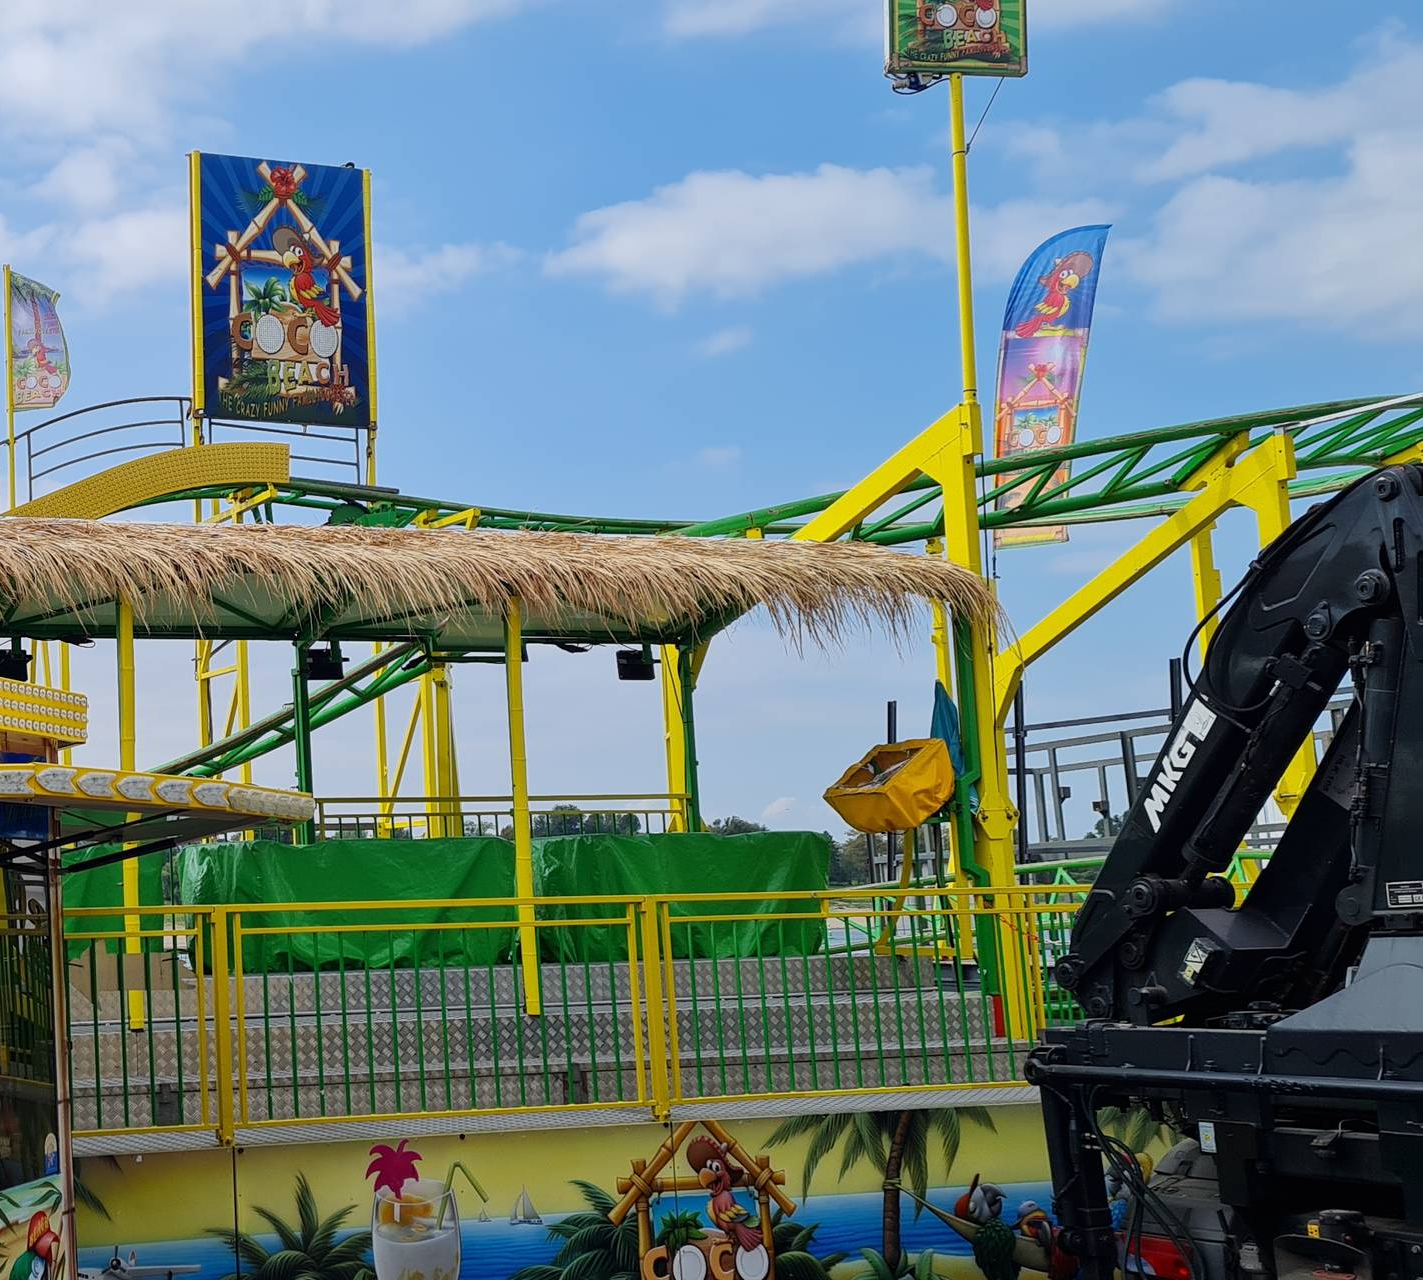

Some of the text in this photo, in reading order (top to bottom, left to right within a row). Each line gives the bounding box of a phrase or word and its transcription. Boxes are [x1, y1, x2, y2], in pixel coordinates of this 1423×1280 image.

[919, 3, 997, 28] COCO
[943, 28, 1007, 49] BEACH
[231, 312, 339, 358] COCO
[17, 375, 62, 389] COCO
[266, 359, 349, 396] BEACH
[236, 399, 259, 418] CRAZY
[263, 399, 289, 417] FUNNY
[1007, 424, 1061, 447] COCO
[1143, 725, 1197, 834] MKG
[643, 1238, 770, 1280] COCO
